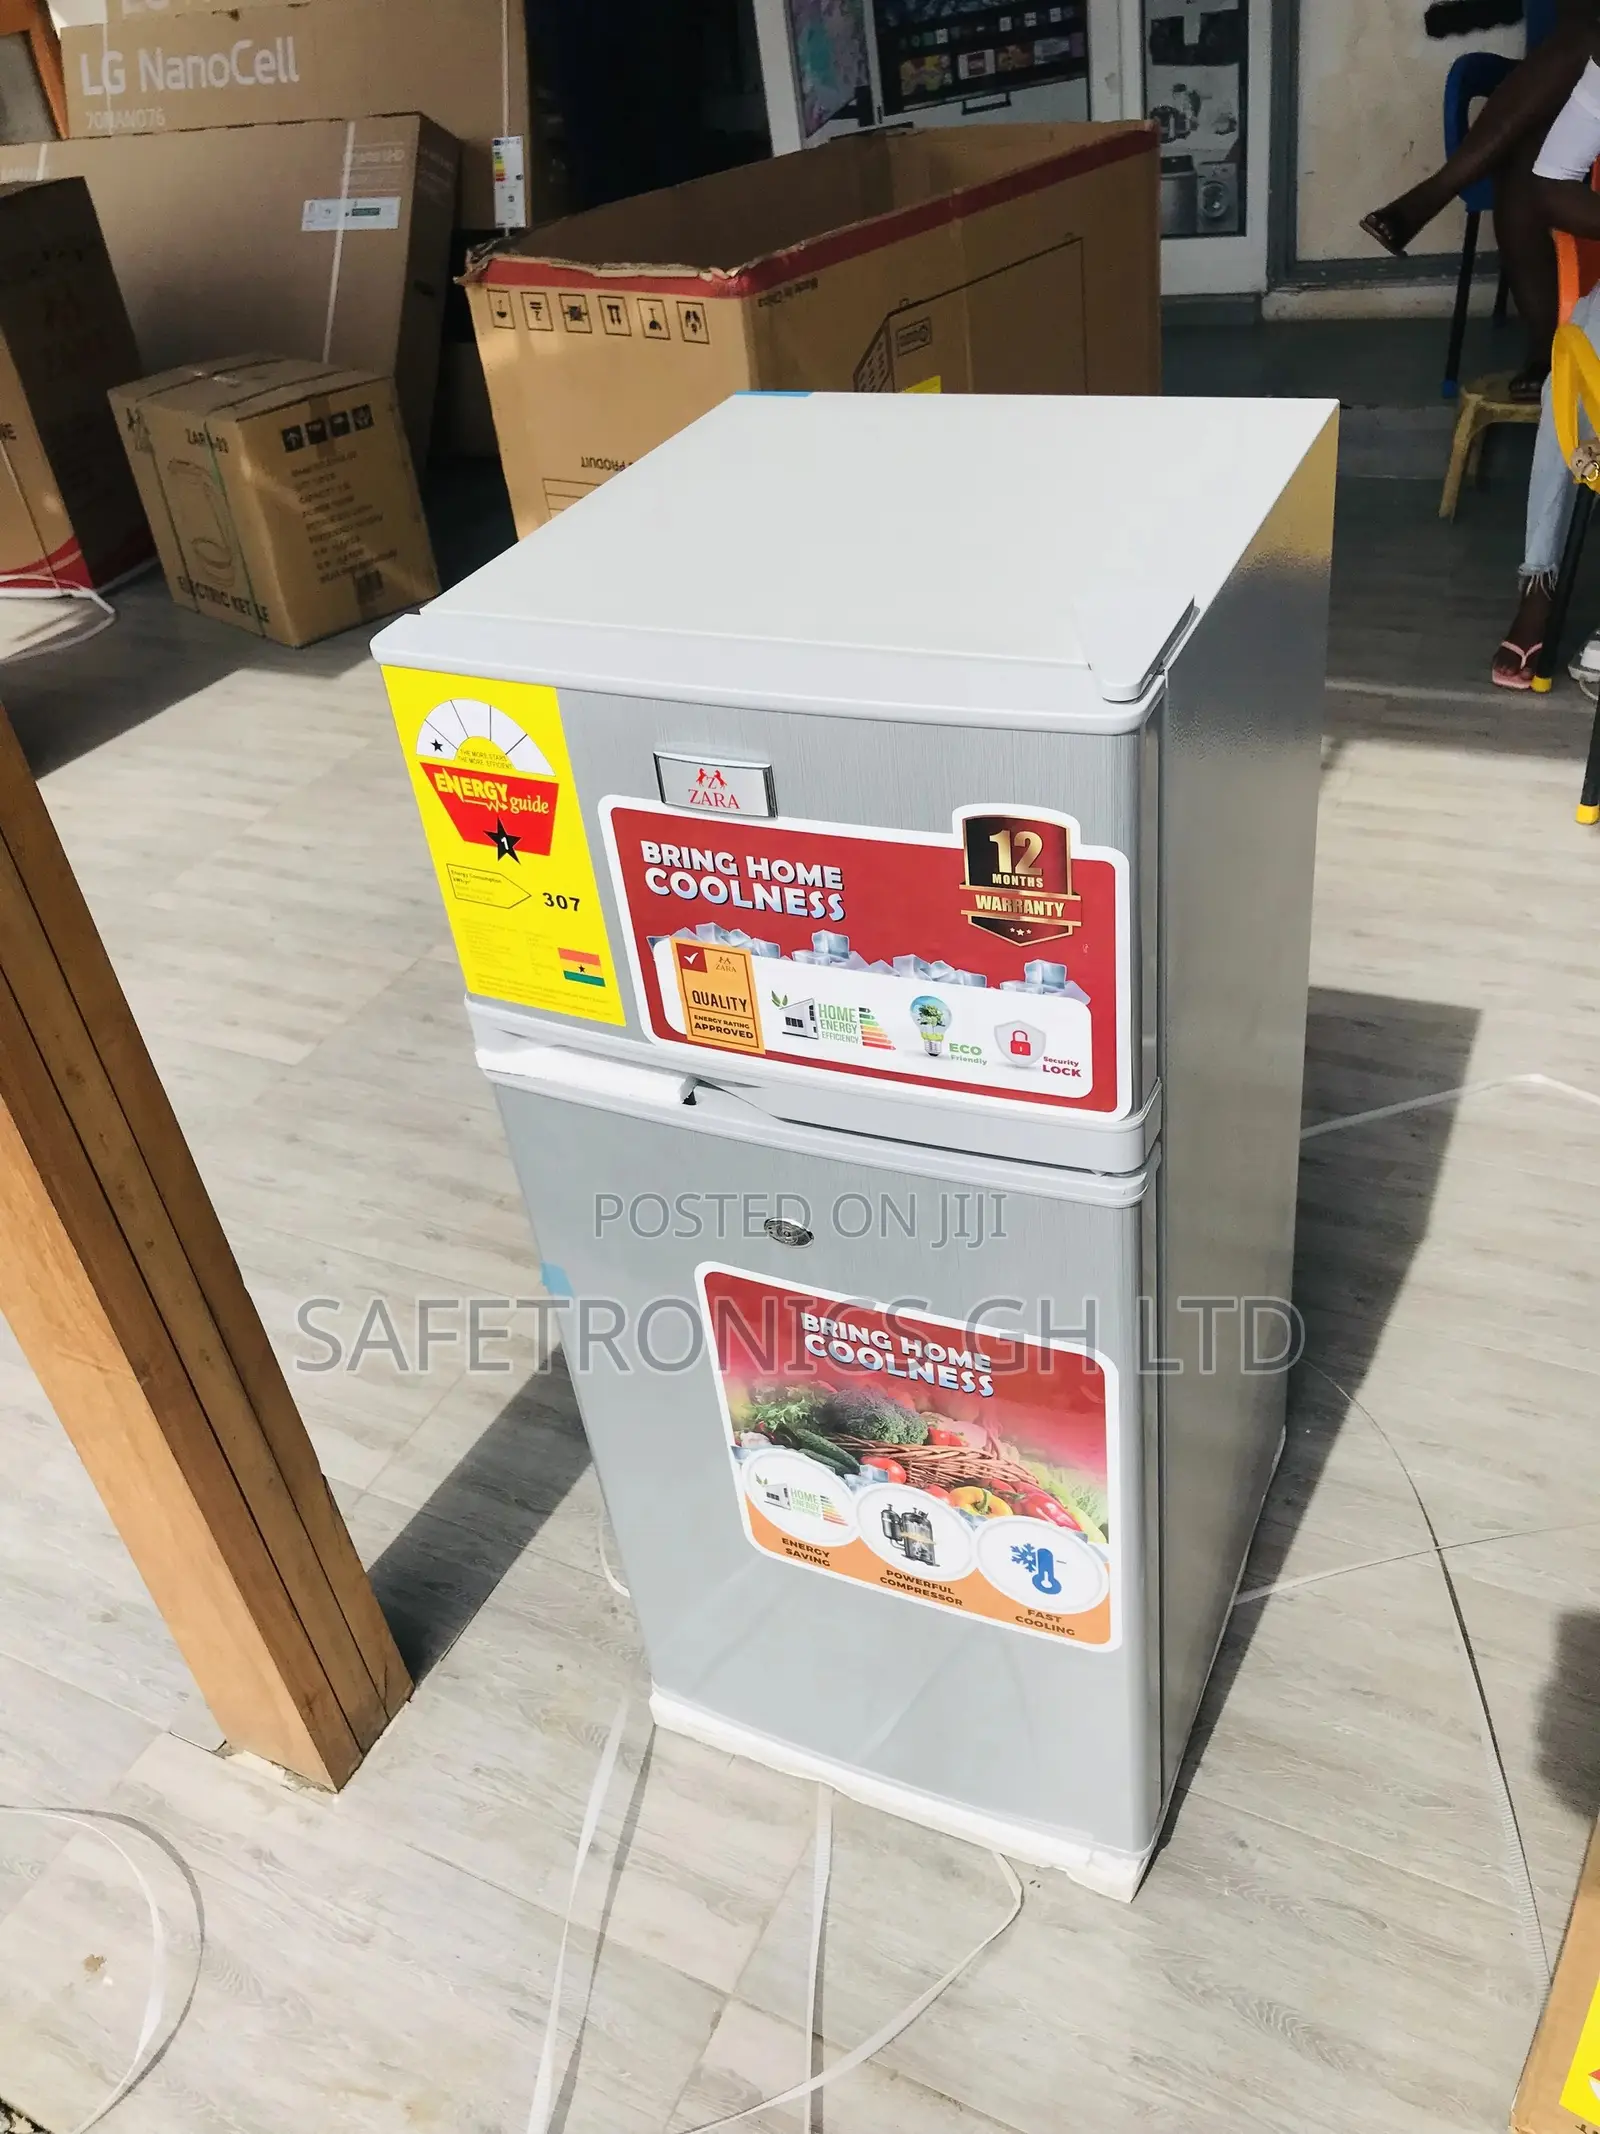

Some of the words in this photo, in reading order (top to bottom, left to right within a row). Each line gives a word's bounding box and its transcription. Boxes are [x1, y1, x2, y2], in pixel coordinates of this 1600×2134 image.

[79, 50, 126, 95] LG
[138, 36, 299, 92] NanoCell
[434, 770, 508, 803] ENERGY
[510, 795, 550, 814] guide
[688, 789, 741, 809] ZARA
[500, 836, 509, 851] 1
[989, 830, 1044, 876] 12
[640, 840, 740, 877] BRING
[745, 855, 845, 891] HOME
[992, 873, 1044, 888] MONTHS
[542, 892, 581, 912] 307
[645, 867, 846, 923] COOLNESS
[975, 894, 1065, 918] WARRANTY
[715, 963, 738, 974] ZARA
[692, 990, 748, 1013] QUALITY
[693, 1014, 722, 1026] ENERGY
[723, 1019, 750, 1030] RATING
[818, 1003, 857, 1024] HOME
[694, 1022, 754, 1040] APPROVED
[820, 1019, 858, 1035] ENERGY
[821, 1031, 860, 1045] EFFICIENCY
[949, 1042, 983, 1056] ECO
[951, 1054, 988, 1066] Friendly
[1043, 1056, 1079, 1067] Security
[1043, 1064, 1082, 1078] LOCK
[800, 1312, 893, 1351] BRING
[900, 1336, 992, 1374] HOME
[804, 1334, 994, 1398] COOLNESS
[791, 1488, 818, 1503] HOME
[782, 1537, 830, 1558] ENERGY
[785, 1548, 831, 1567] SAVING
[880, 1576, 963, 1607] COMPRESSOR
[886, 1569, 955, 1595] POWERFUL
[1015, 1615, 1075, 1636] COOLING
[1027, 1609, 1062, 1623] FAST
